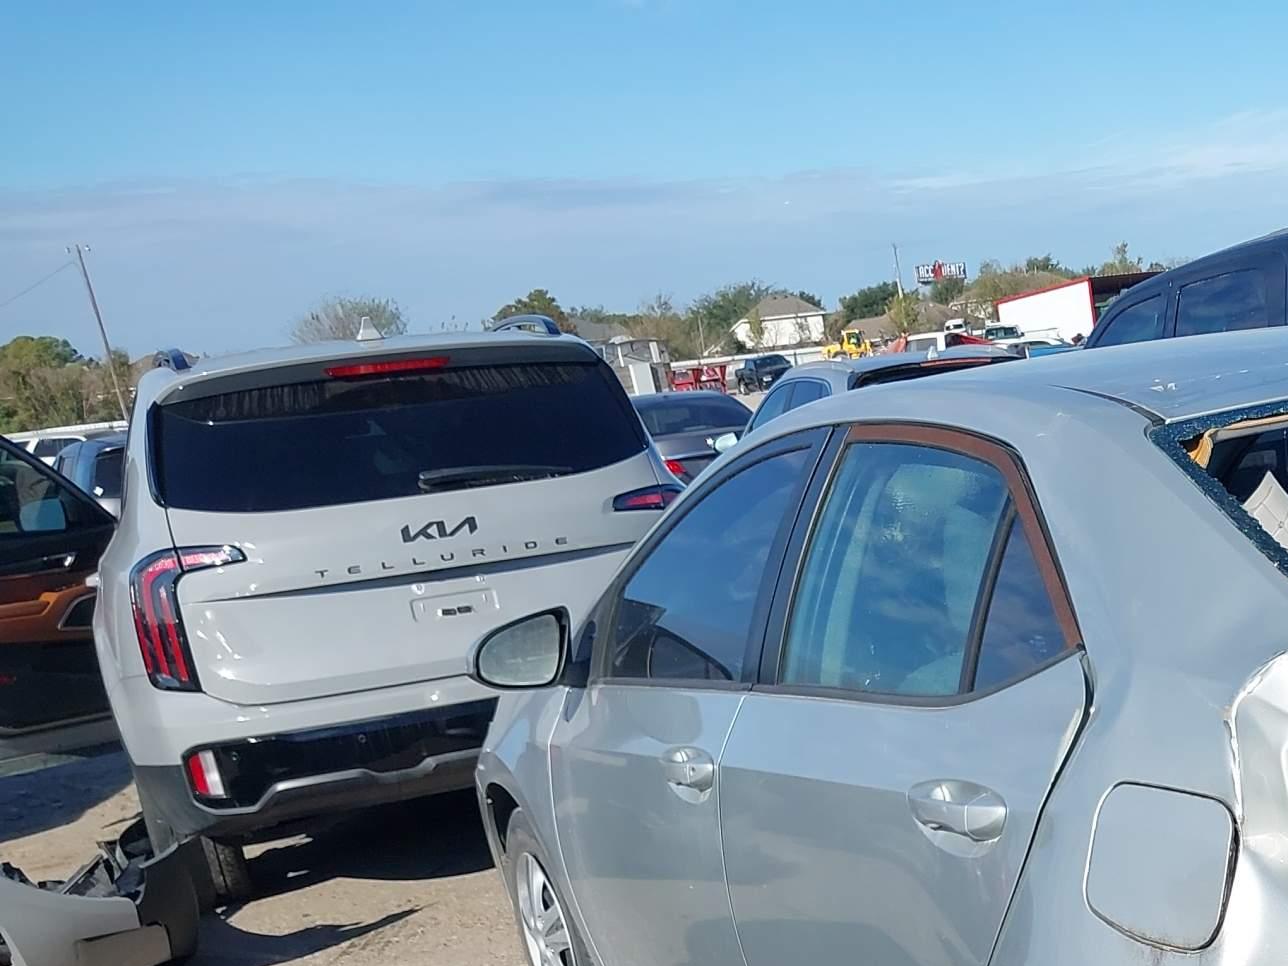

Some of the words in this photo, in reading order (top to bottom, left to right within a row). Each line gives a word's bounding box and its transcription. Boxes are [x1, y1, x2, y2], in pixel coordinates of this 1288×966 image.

[919, 262, 964, 278] ACCDENT?
[400, 516, 478, 543] KIA
[315, 536, 568, 579] TELLURIDE
